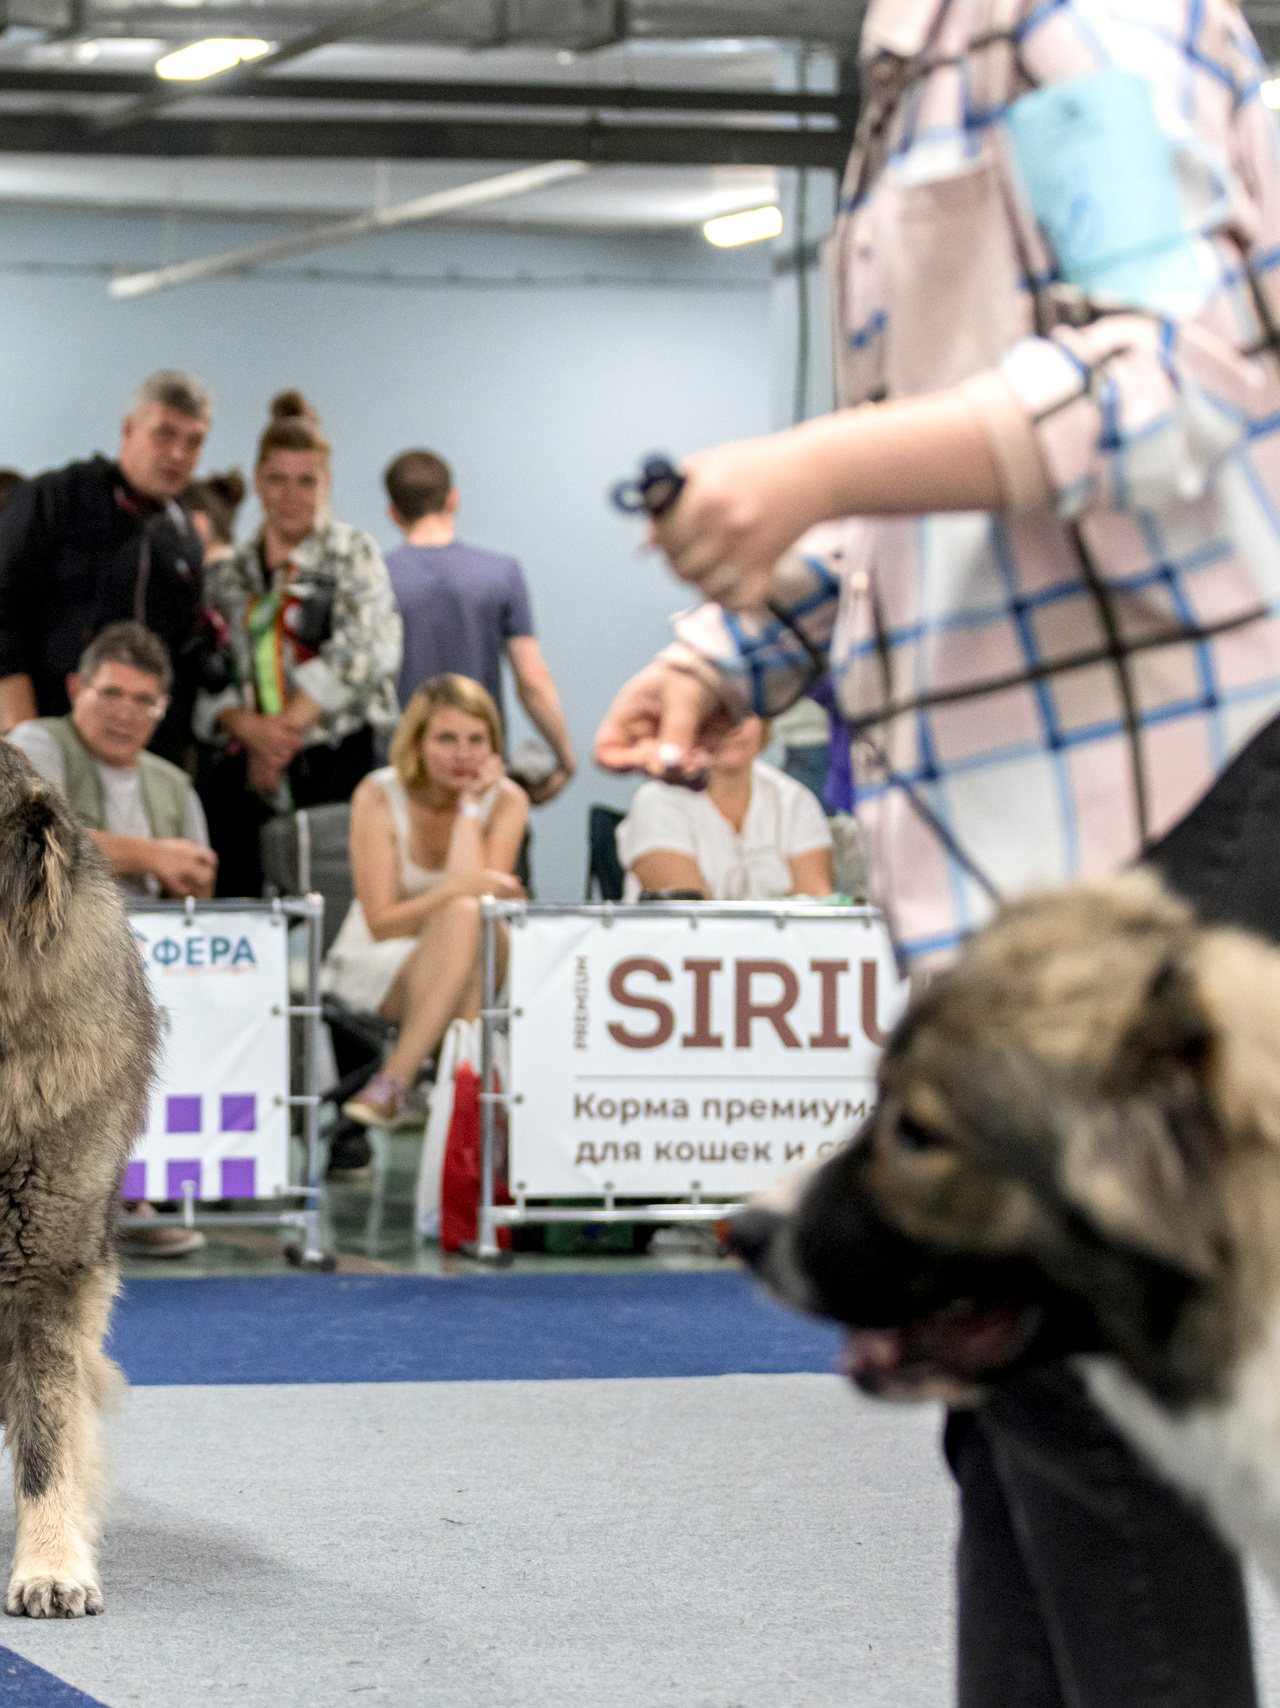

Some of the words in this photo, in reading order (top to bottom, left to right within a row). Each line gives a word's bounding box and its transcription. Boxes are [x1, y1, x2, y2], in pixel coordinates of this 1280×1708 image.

[133, 932, 257, 967] ФЕРА
[573, 1094, 688, 1123] Корма
[575, 1141, 641, 1165] для
[654, 1141, 771, 1162] кошек
[785, 1141, 805, 1162] и
